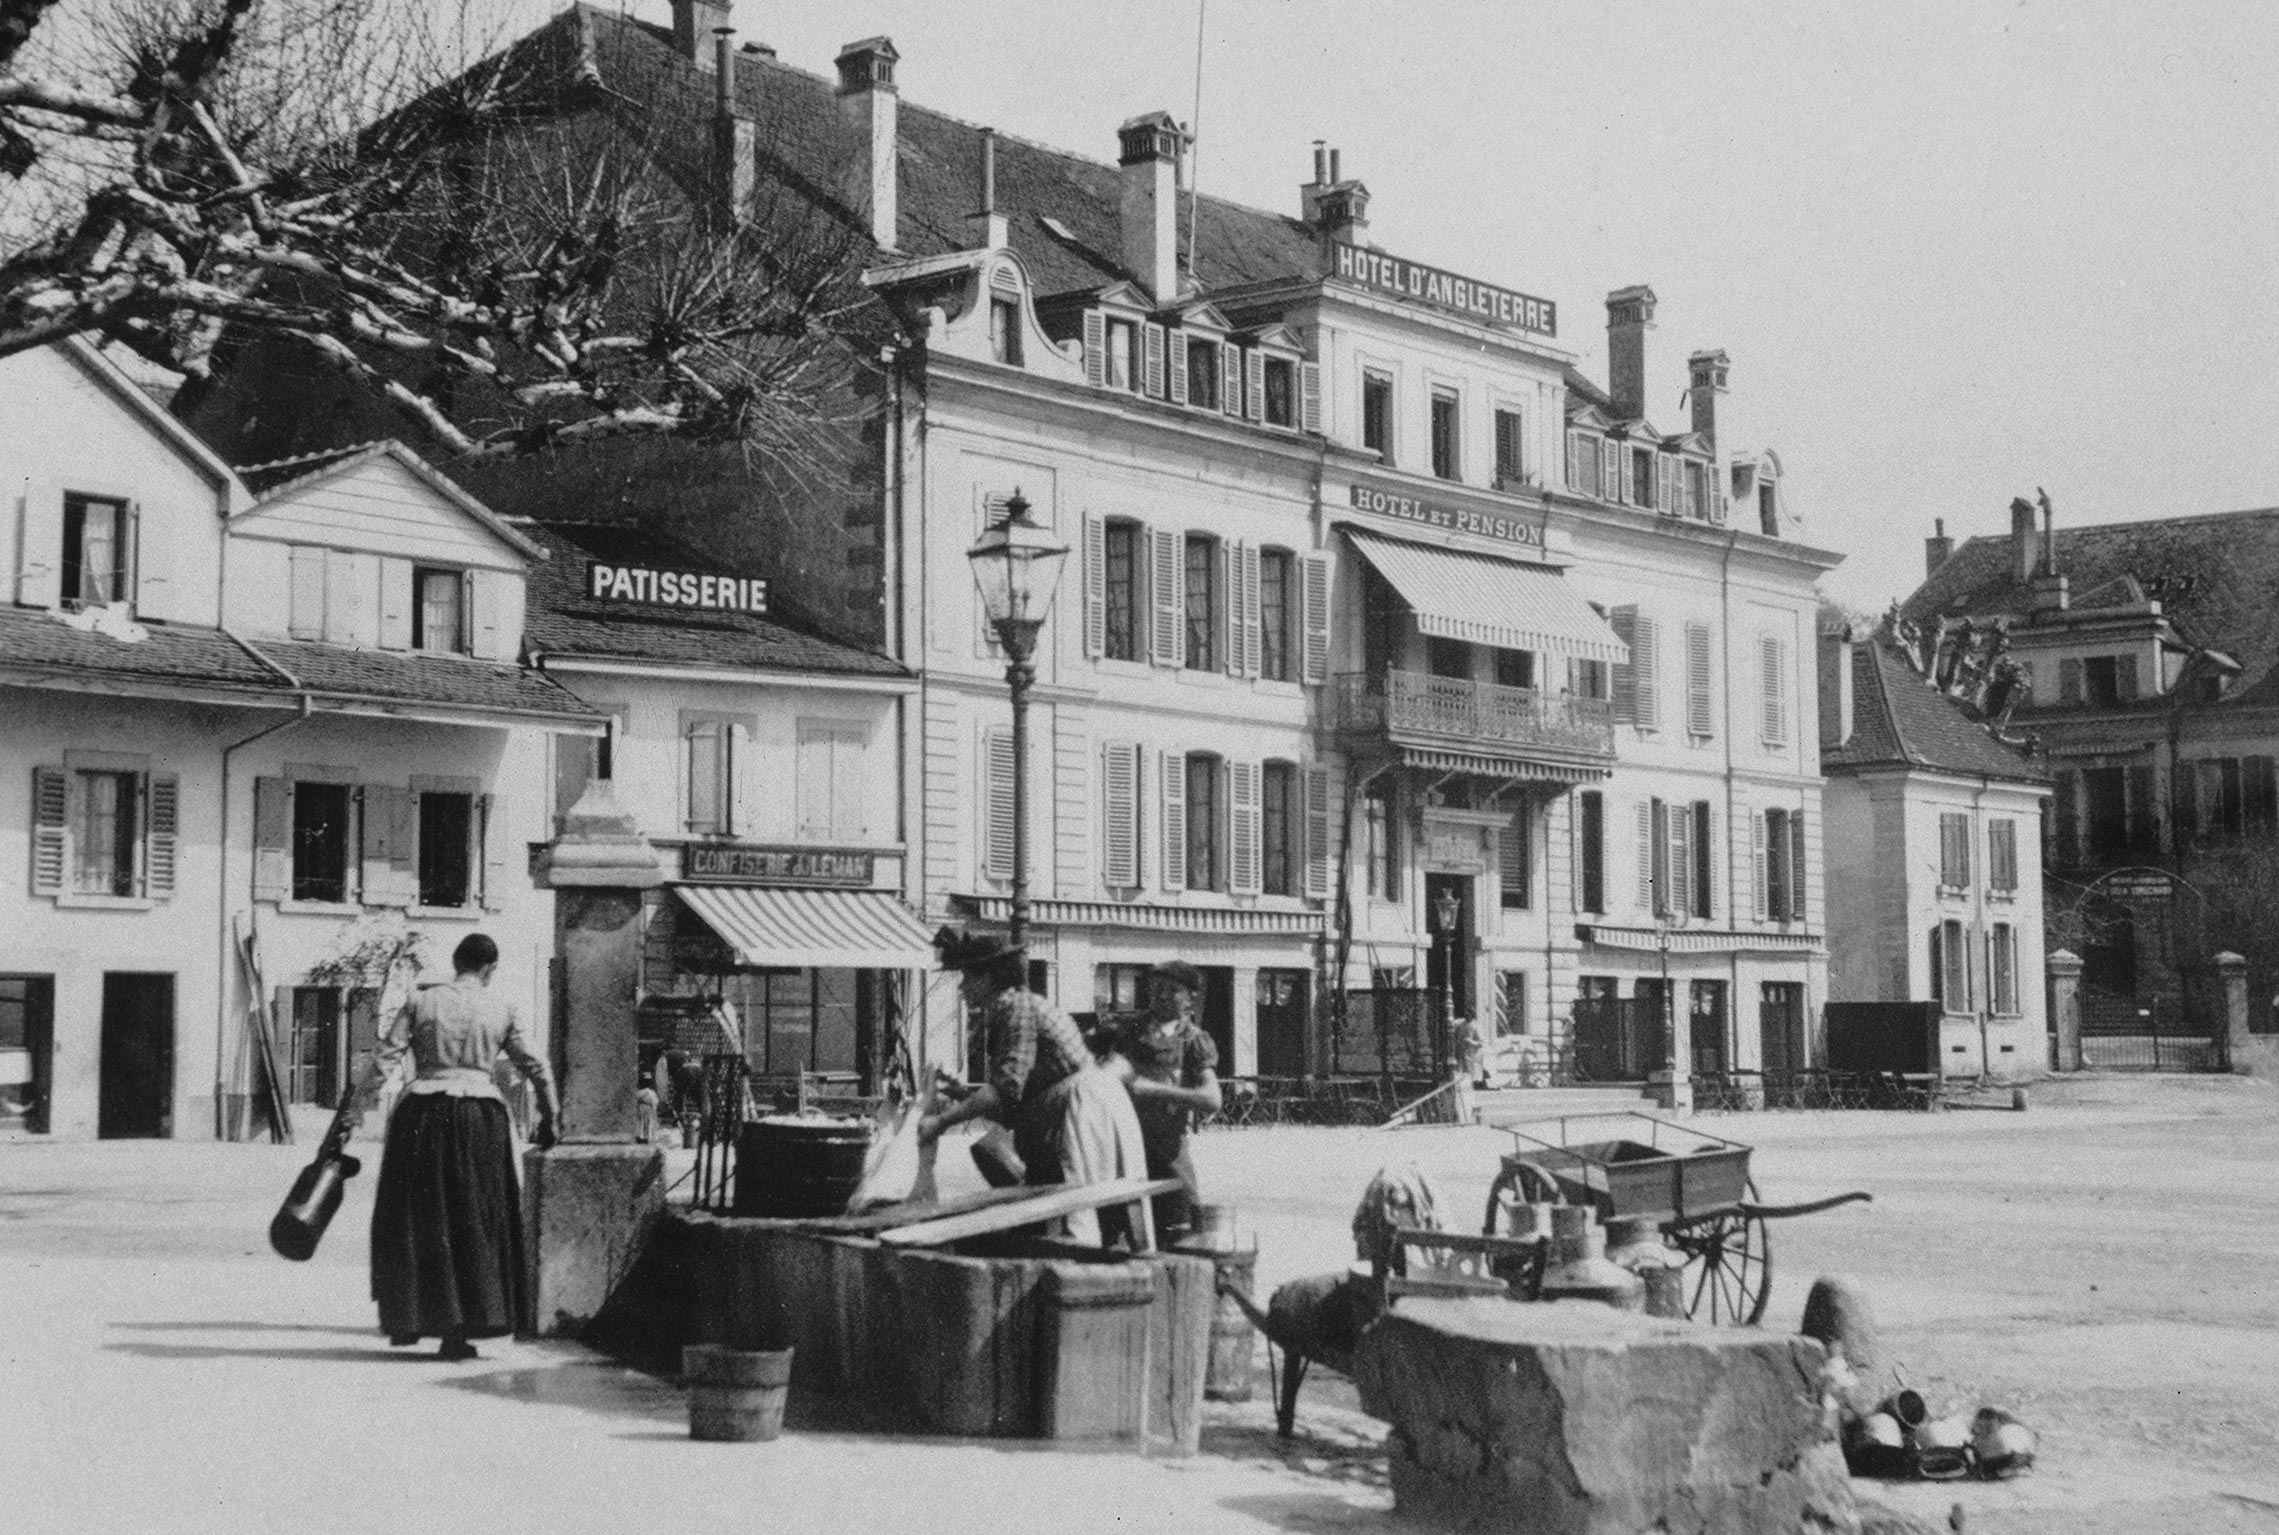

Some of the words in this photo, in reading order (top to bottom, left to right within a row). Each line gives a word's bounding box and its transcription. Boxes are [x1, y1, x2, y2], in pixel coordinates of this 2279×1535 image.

[1339, 245, 1404, 292] HOTEL
[1408, 266, 1550, 332] D'ANGLETERRE
[1357, 488, 1425, 521] HOTEL
[1456, 510, 1542, 545] PENSION
[593, 564, 767, 612] PATISSERIE
[694, 850, 791, 875] CONFISERIE
